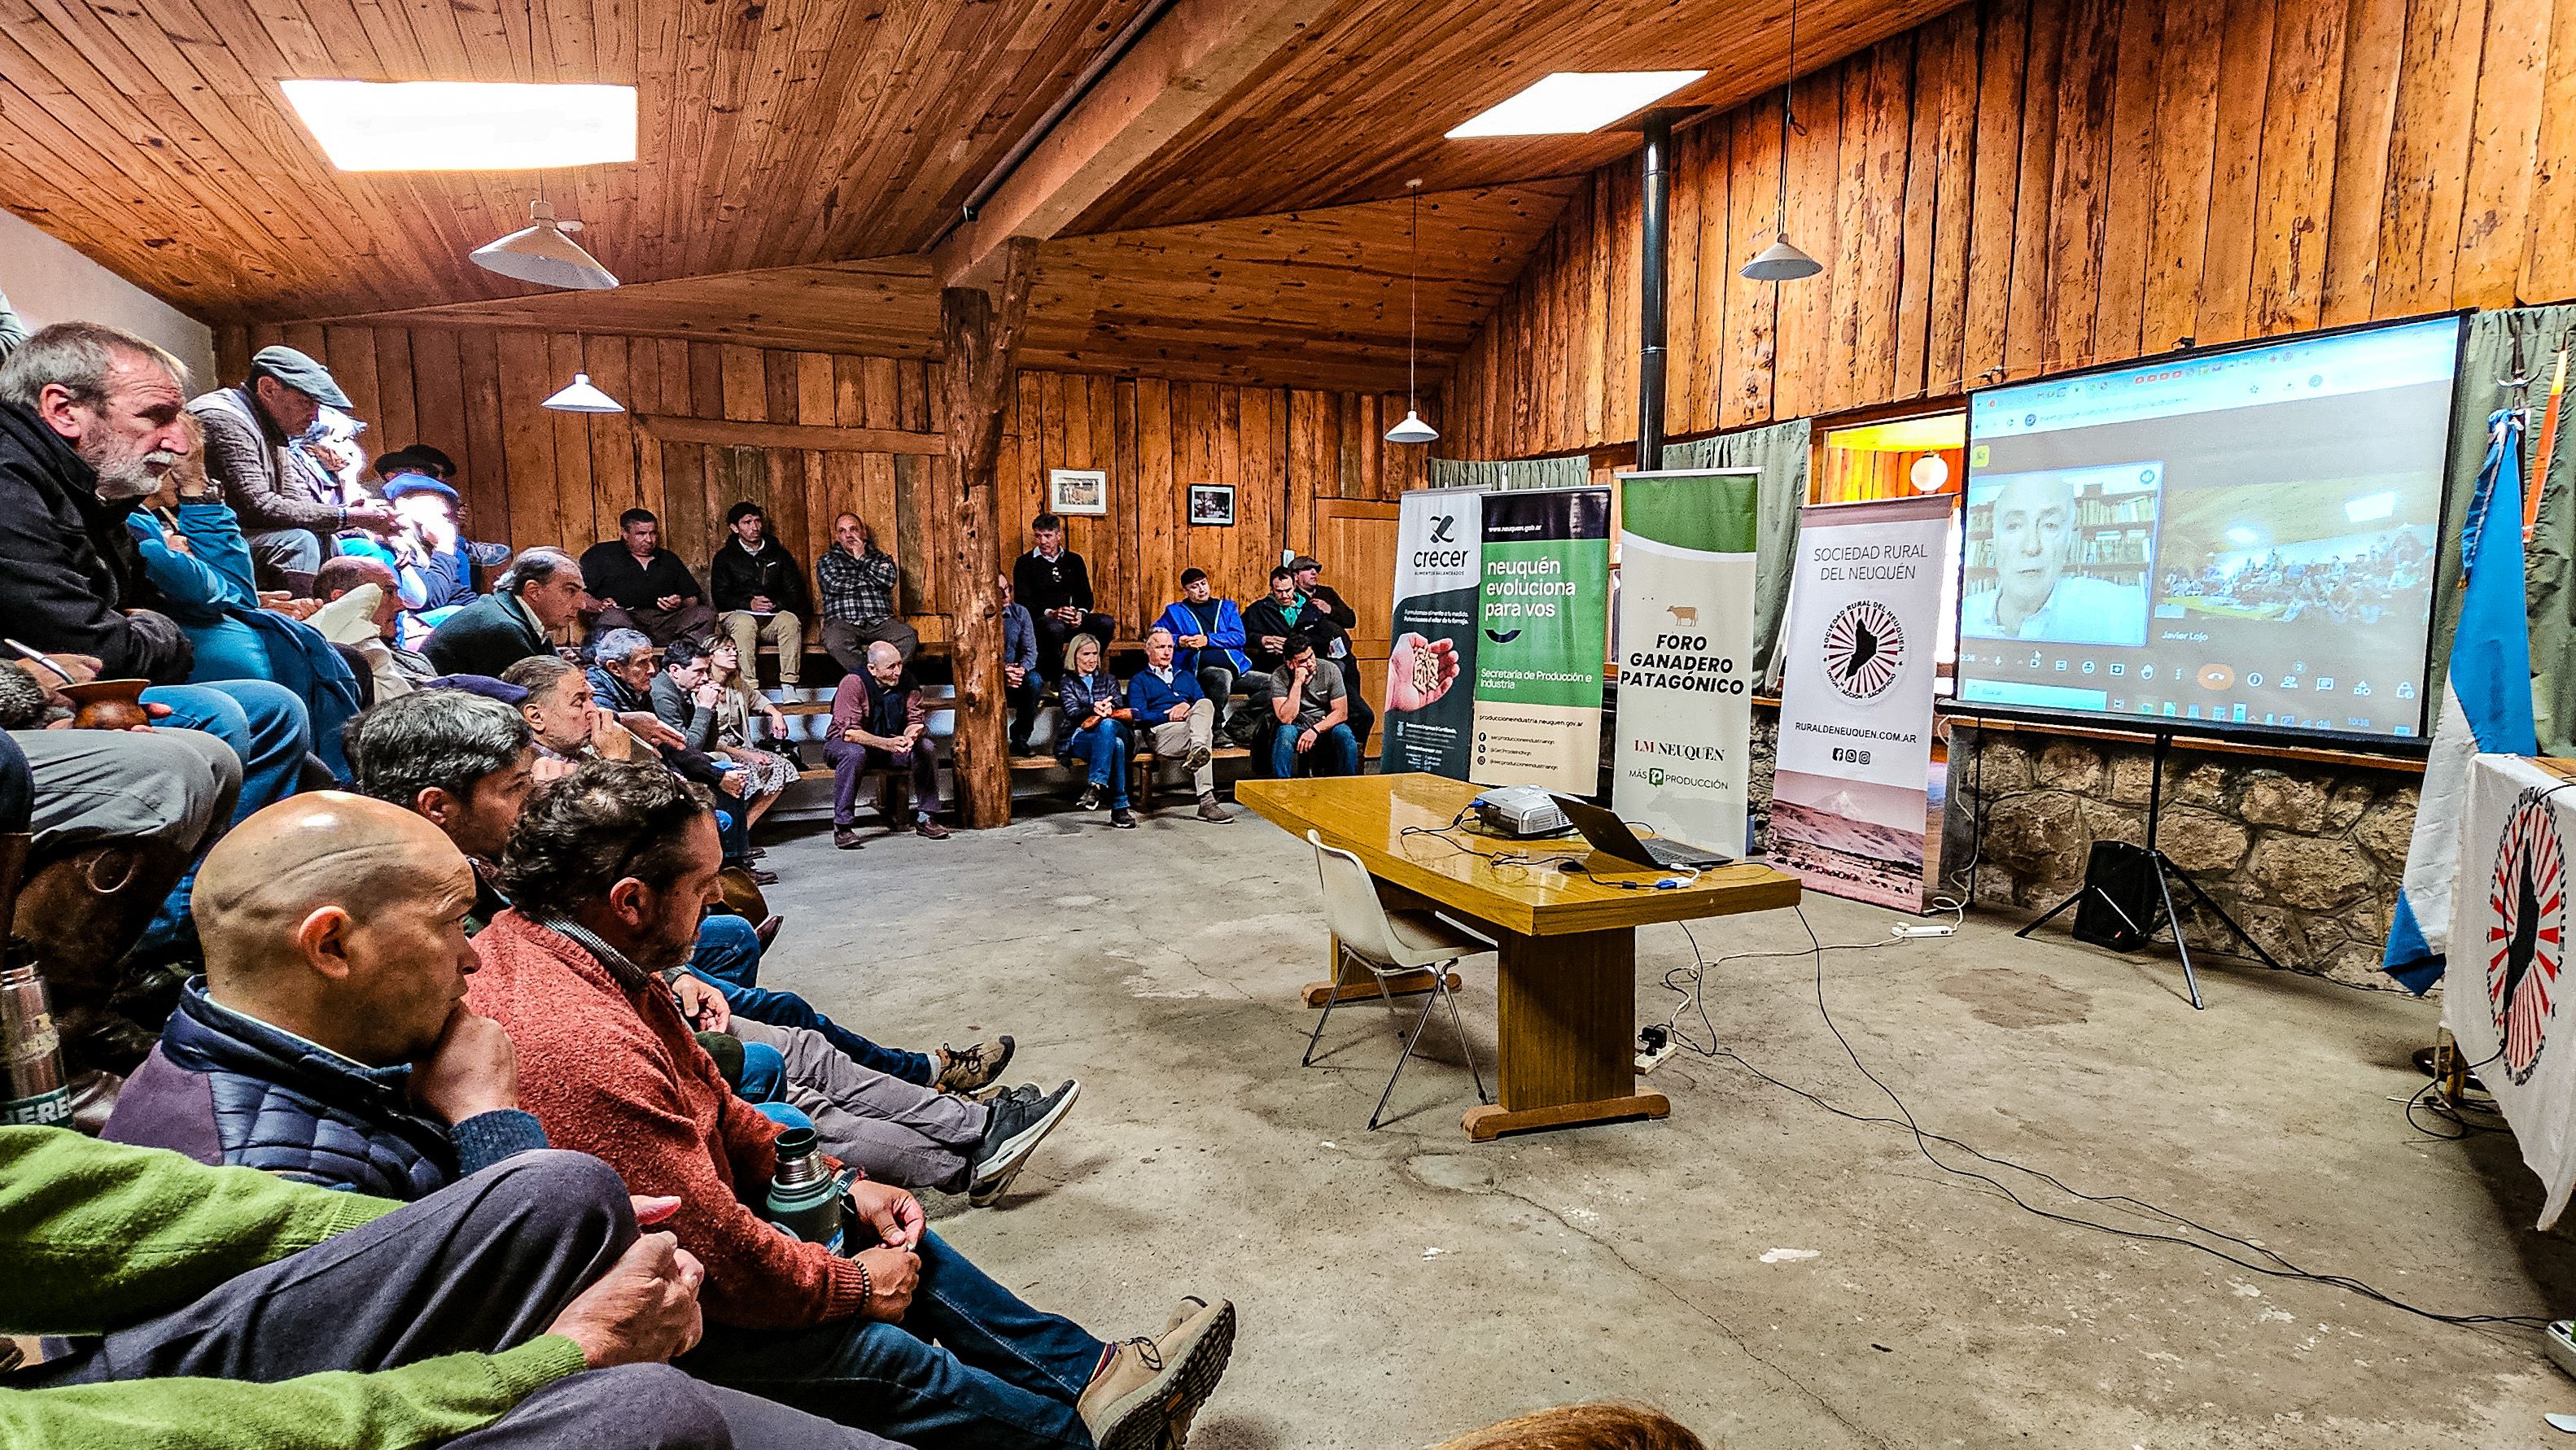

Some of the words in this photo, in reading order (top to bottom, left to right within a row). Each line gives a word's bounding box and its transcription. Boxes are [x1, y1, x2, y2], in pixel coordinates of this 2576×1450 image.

[1414, 550, 1468, 568] crecer
[1813, 546, 1880, 561] SOCIEDAD
[1884, 544, 1928, 560] RURAL
[1487, 556, 1561, 579] neuquén
[1821, 567, 1845, 580] DEL
[1848, 562, 1916, 580] NEUQUÉN
[1486, 578, 1577, 596] evoluciona
[1485, 603, 1521, 622] para
[1524, 603, 1555, 617] vos
[1823, 609, 1845, 649] SOCIEDAD
[1846, 600, 1871, 612] RURAL
[1873, 601, 1887, 613] DEL
[1656, 634, 1708, 651] FORO
[1630, 653, 1734, 674] GANADERO
[1480, 668, 1523, 679] Secretaría
[1524, 670, 1535, 680] de
[1536, 670, 1584, 682] Producción
[1585, 675, 1593, 683] e
[1480, 679, 1515, 689] Industria
[1620, 670, 1744, 695] PATAGÓNICO
[1795, 722, 1917, 744] RURALDENEUQUEN.COM.AR
[1634, 740, 1655, 753] LM
[1629, 768, 1647, 780] MÁS
[1665, 774, 1729, 790] PRODUCCIÓN
